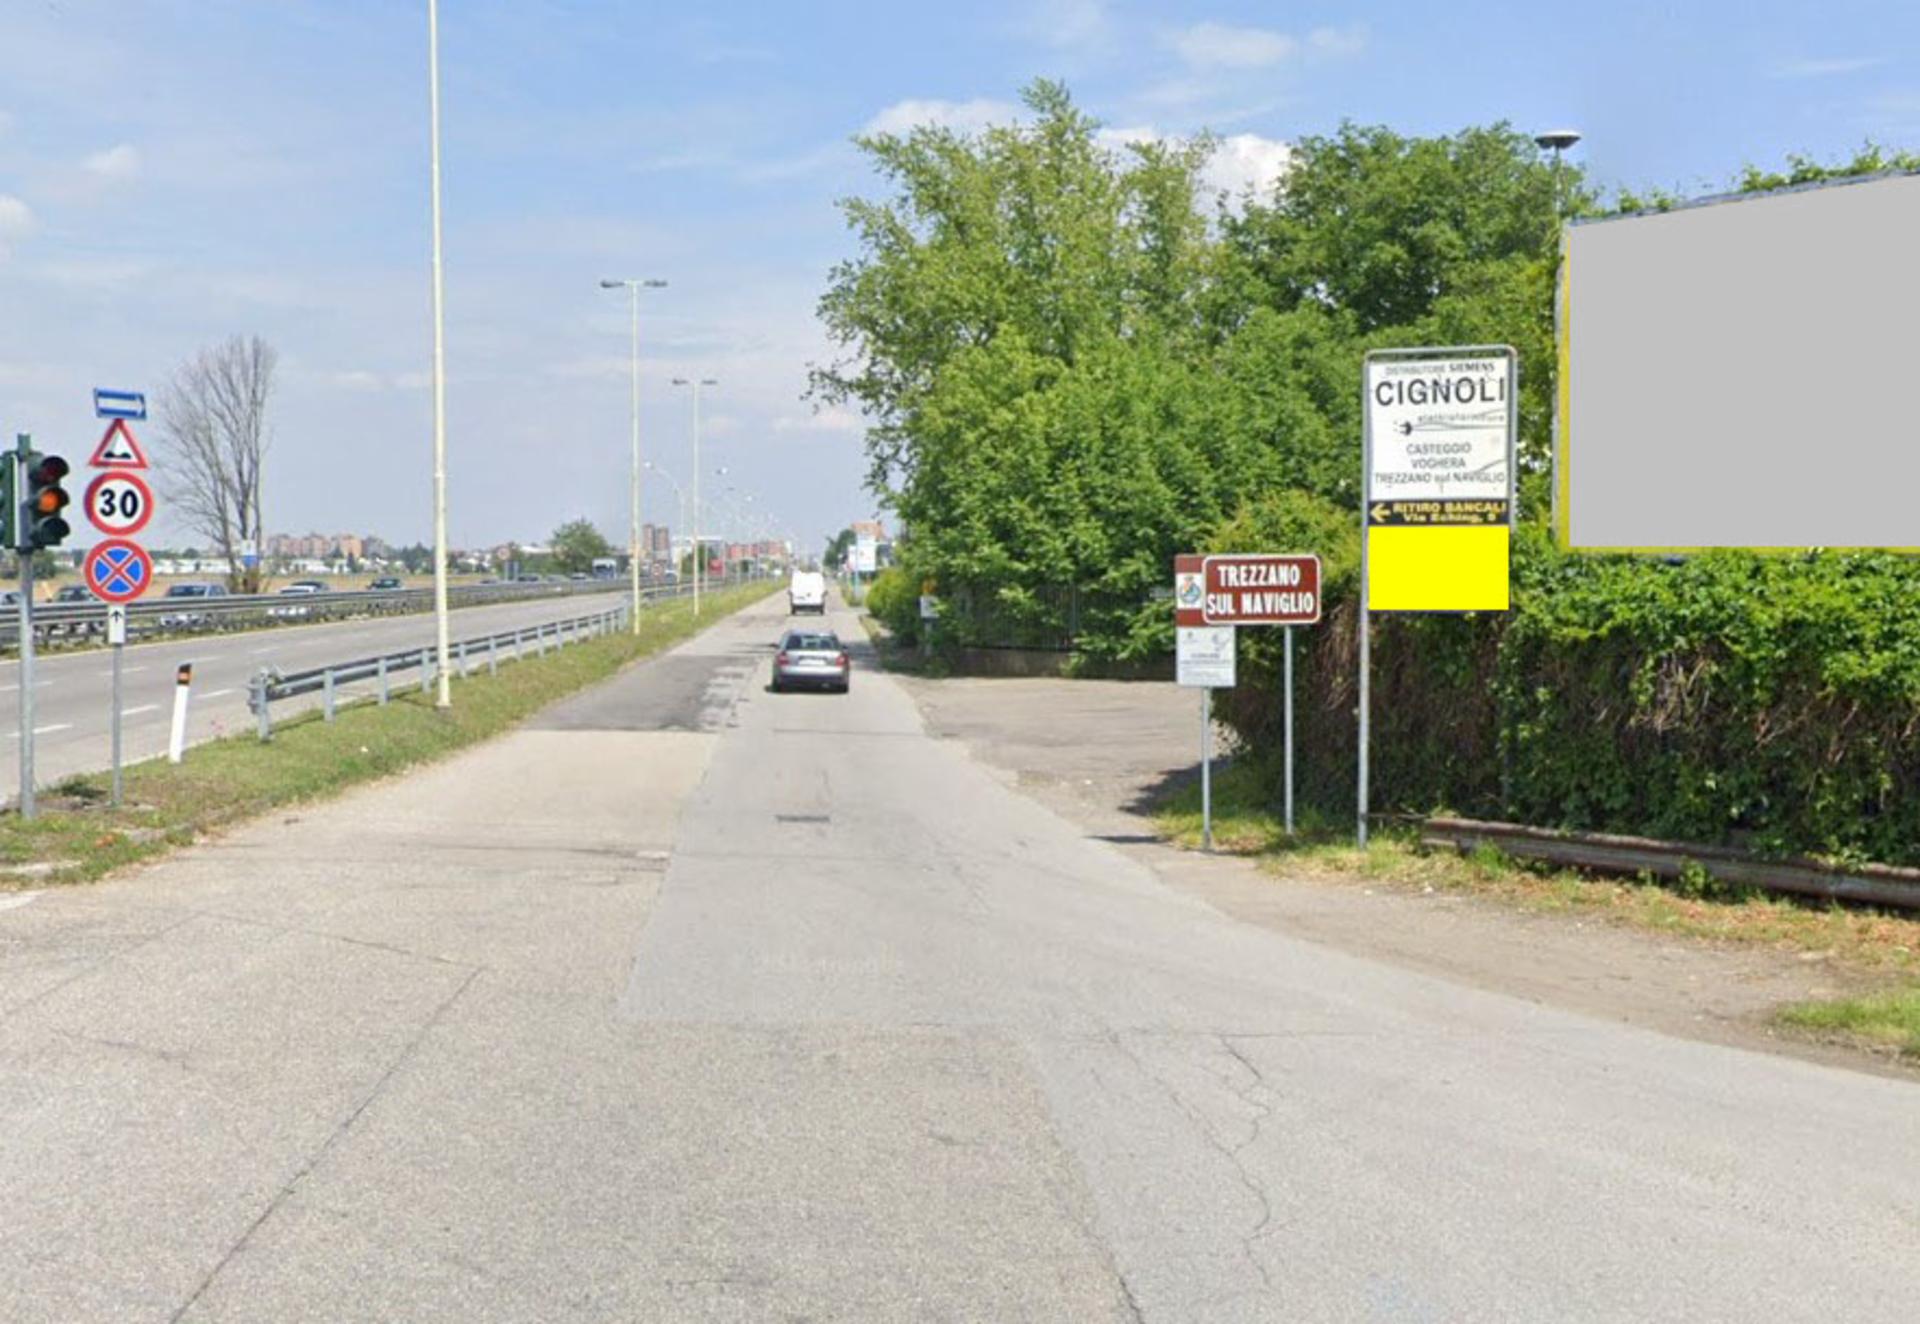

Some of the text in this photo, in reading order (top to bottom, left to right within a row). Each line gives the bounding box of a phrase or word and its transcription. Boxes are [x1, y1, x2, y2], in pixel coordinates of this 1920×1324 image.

[1449, 362, 1495, 372] SIEMENS
[1375, 377, 1505, 406] CIGNOLI
[1406, 442, 1472, 455] CASTEGGIO
[1411, 457, 1466, 469] VOGHERA
[1376, 472, 1432, 484] TREZZANO
[1453, 471, 1505, 483] NAVIGLIO
[100, 488, 138, 518] 30
[1392, 502, 1507, 513] RITIRO BANCALI
[1217, 564, 1301, 587] TREZZANO
[1207, 591, 1315, 615] SUL NAVIGLIO
